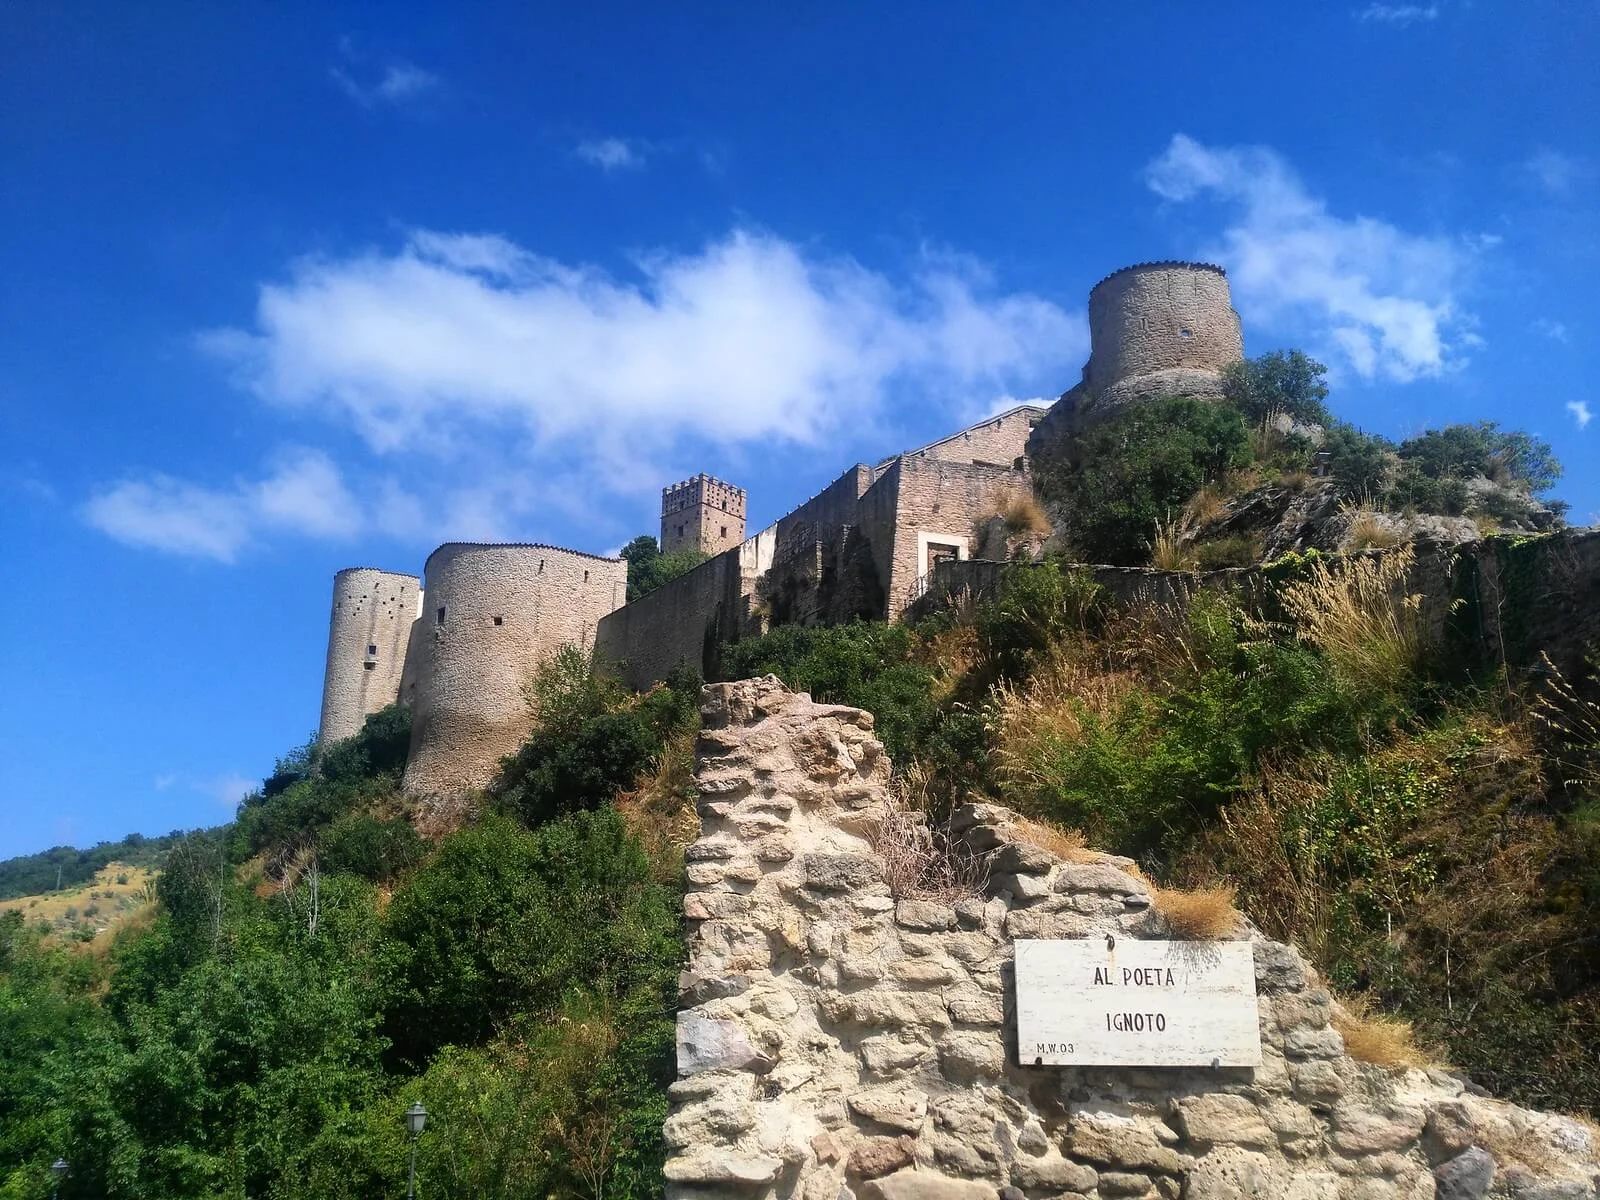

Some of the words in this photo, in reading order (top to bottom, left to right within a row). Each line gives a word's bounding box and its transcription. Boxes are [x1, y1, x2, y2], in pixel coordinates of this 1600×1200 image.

[1094, 967, 1114, 986] AL
[1123, 967, 1175, 986] POETA
[1106, 1013, 1166, 1032] IGNOTO
